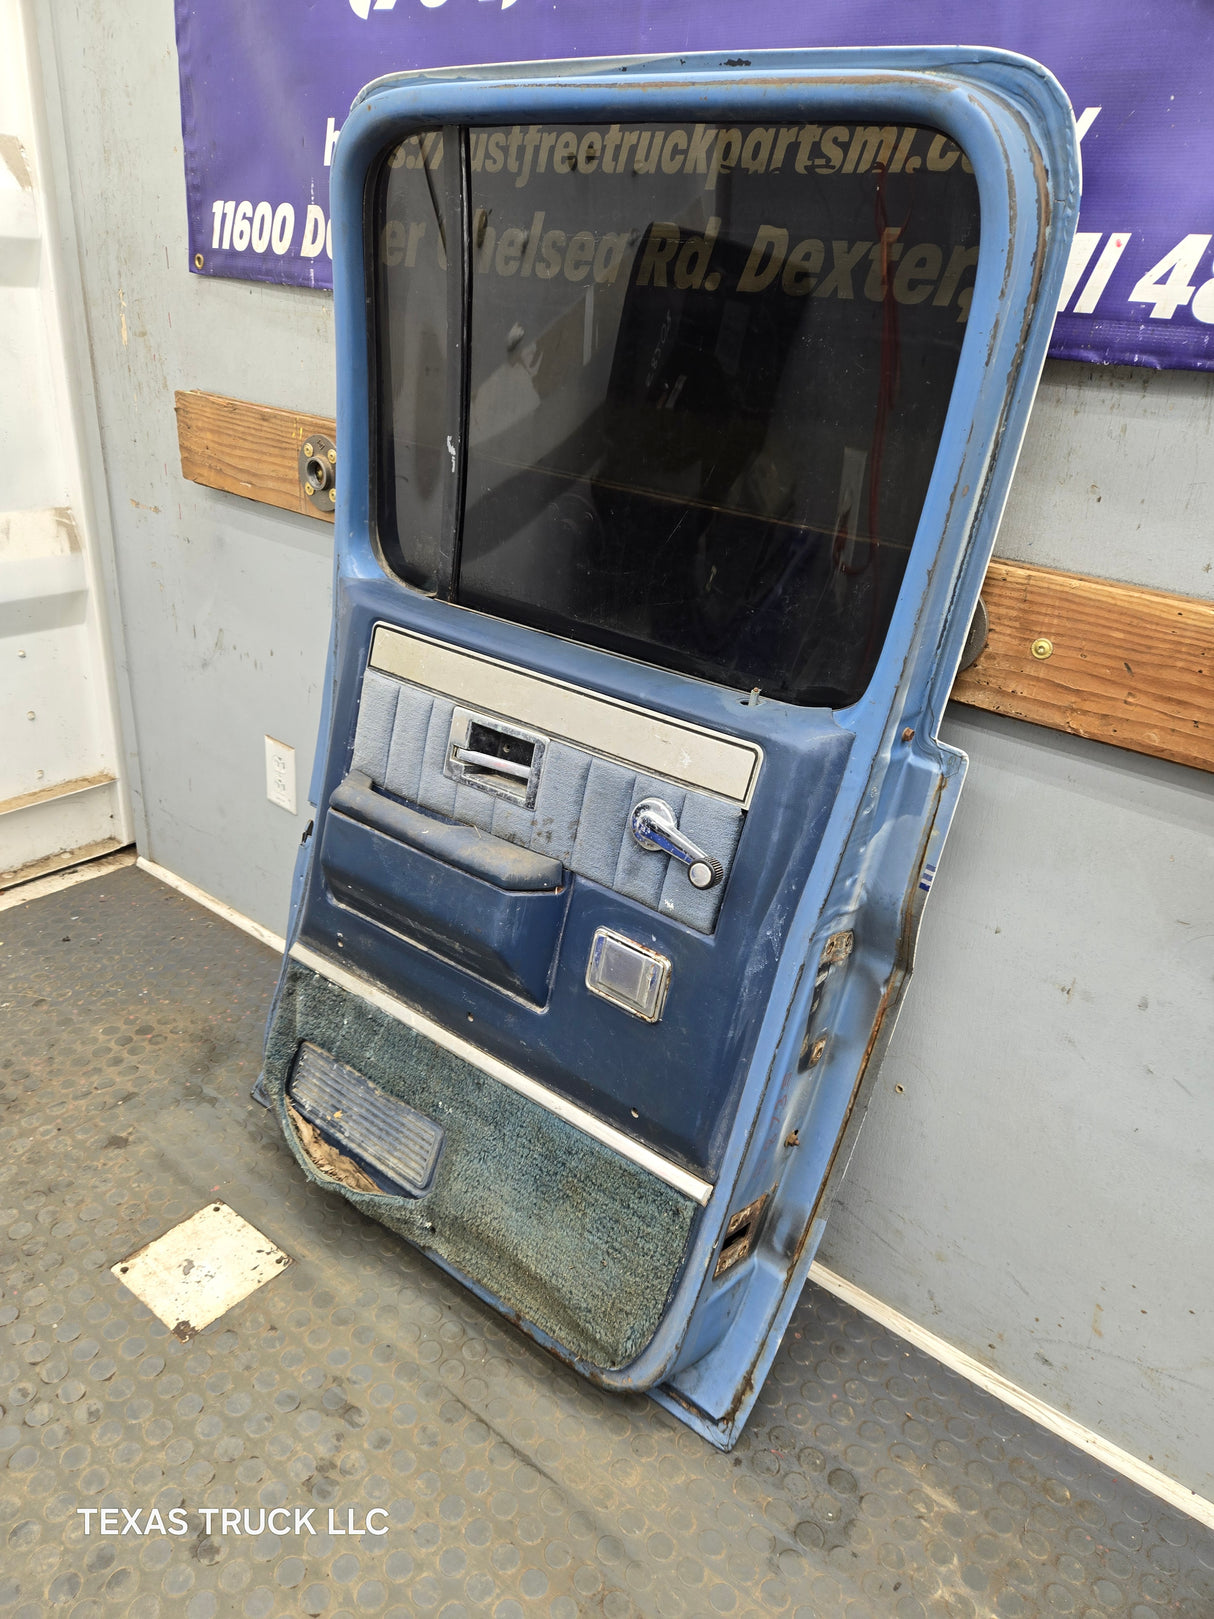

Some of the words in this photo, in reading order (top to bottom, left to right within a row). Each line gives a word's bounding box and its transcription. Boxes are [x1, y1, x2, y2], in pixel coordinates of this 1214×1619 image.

[211, 200, 295, 254] 11600
[438, 209, 631, 284] helsea
[635, 217, 723, 292] Rd.
[735, 225, 977, 323] Dexter,
